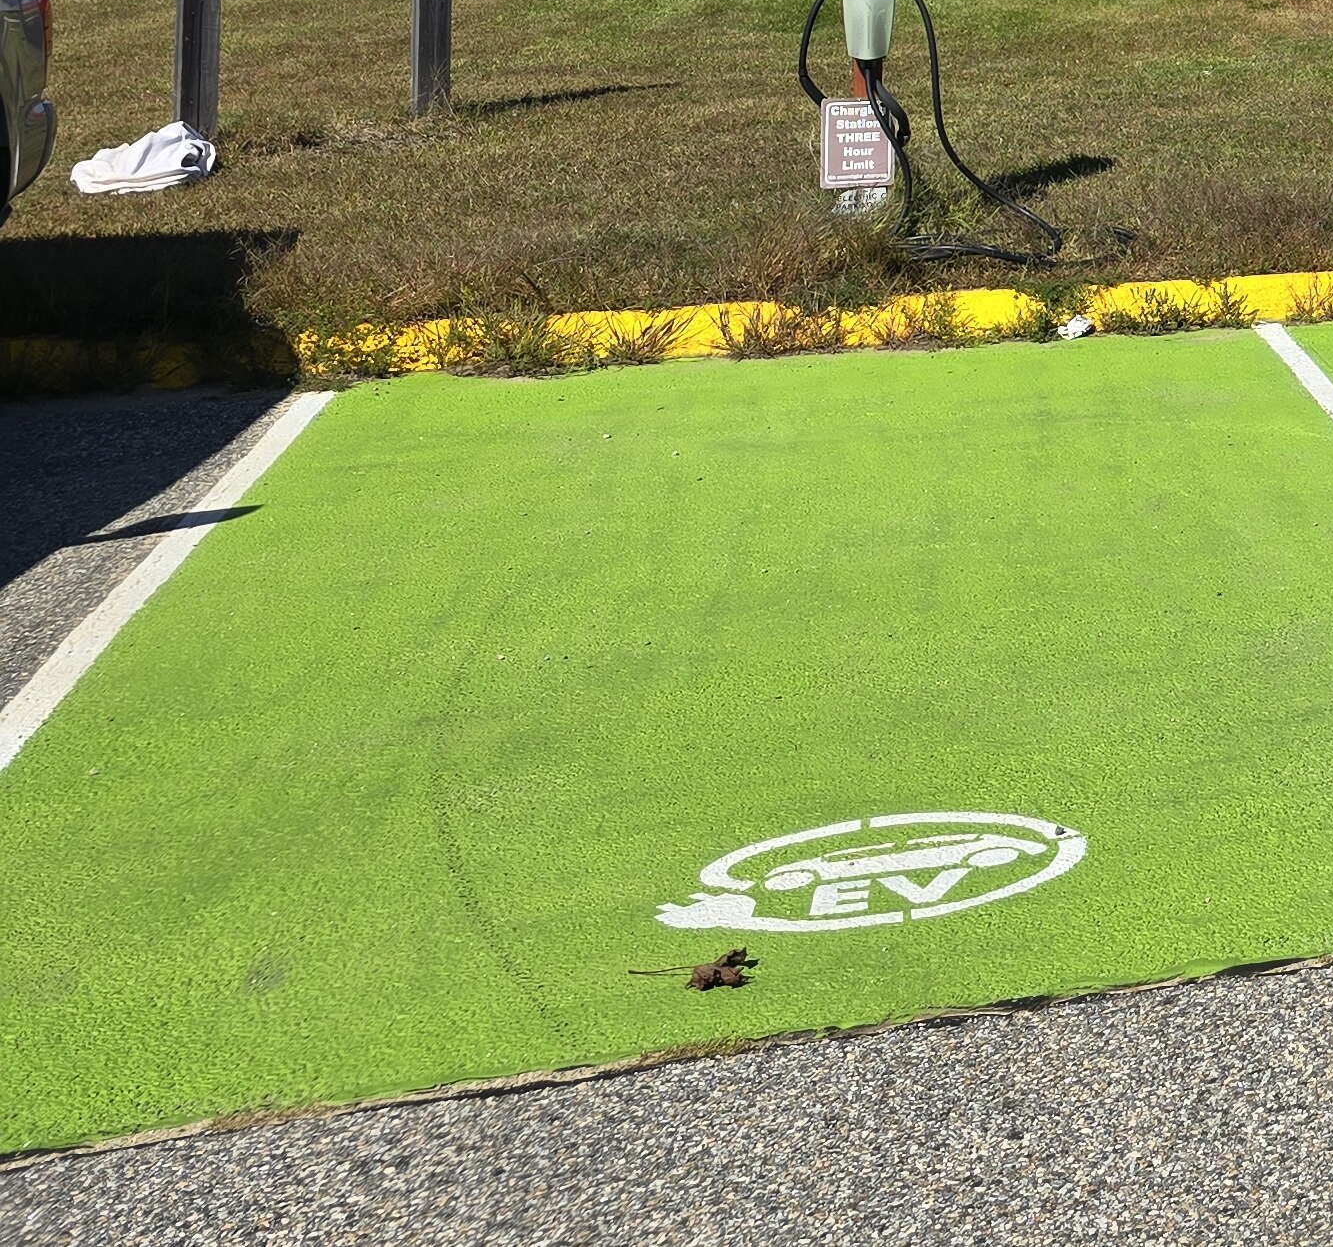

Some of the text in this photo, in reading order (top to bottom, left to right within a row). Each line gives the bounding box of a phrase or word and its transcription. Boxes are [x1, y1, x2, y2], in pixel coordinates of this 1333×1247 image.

[837, 132, 880, 143] THREE
[843, 146, 874, 157] Hour
[842, 160, 875, 171] Limit
[808, 867, 971, 917] EV
